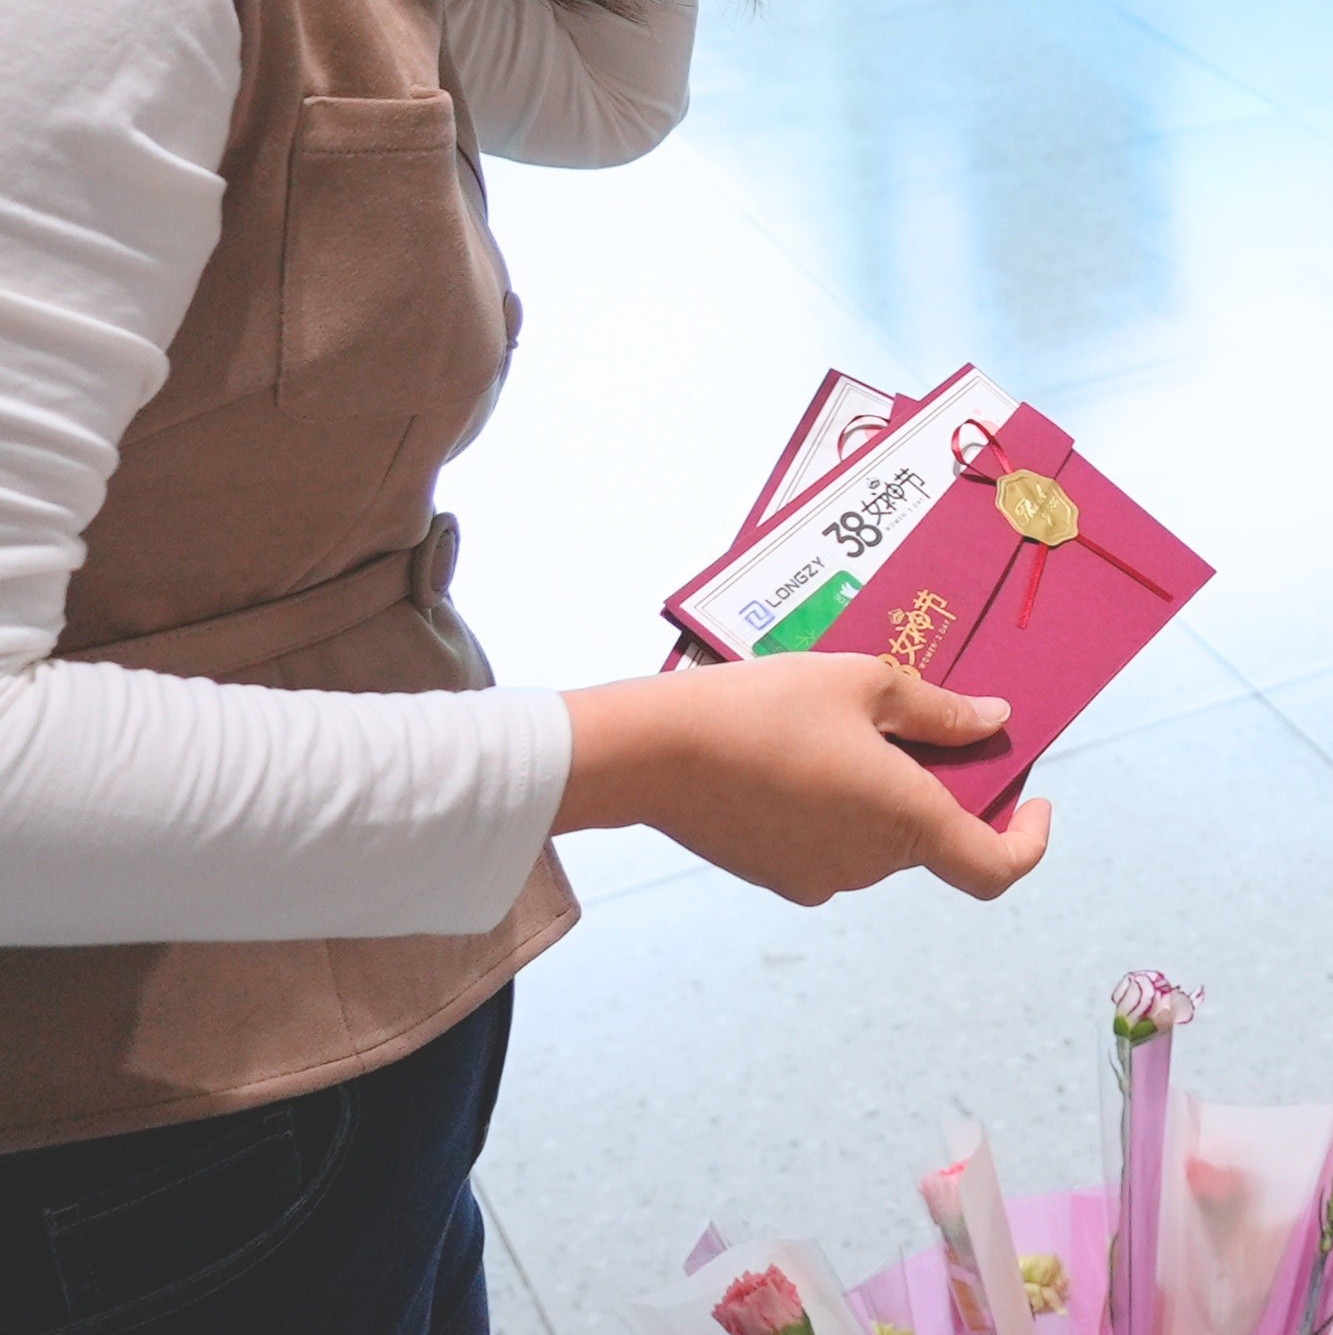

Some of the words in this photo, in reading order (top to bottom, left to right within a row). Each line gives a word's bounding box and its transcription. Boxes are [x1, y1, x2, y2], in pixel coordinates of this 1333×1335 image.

[765, 556, 825, 608] LONGZY
[879, 589, 957, 680] 女神节
